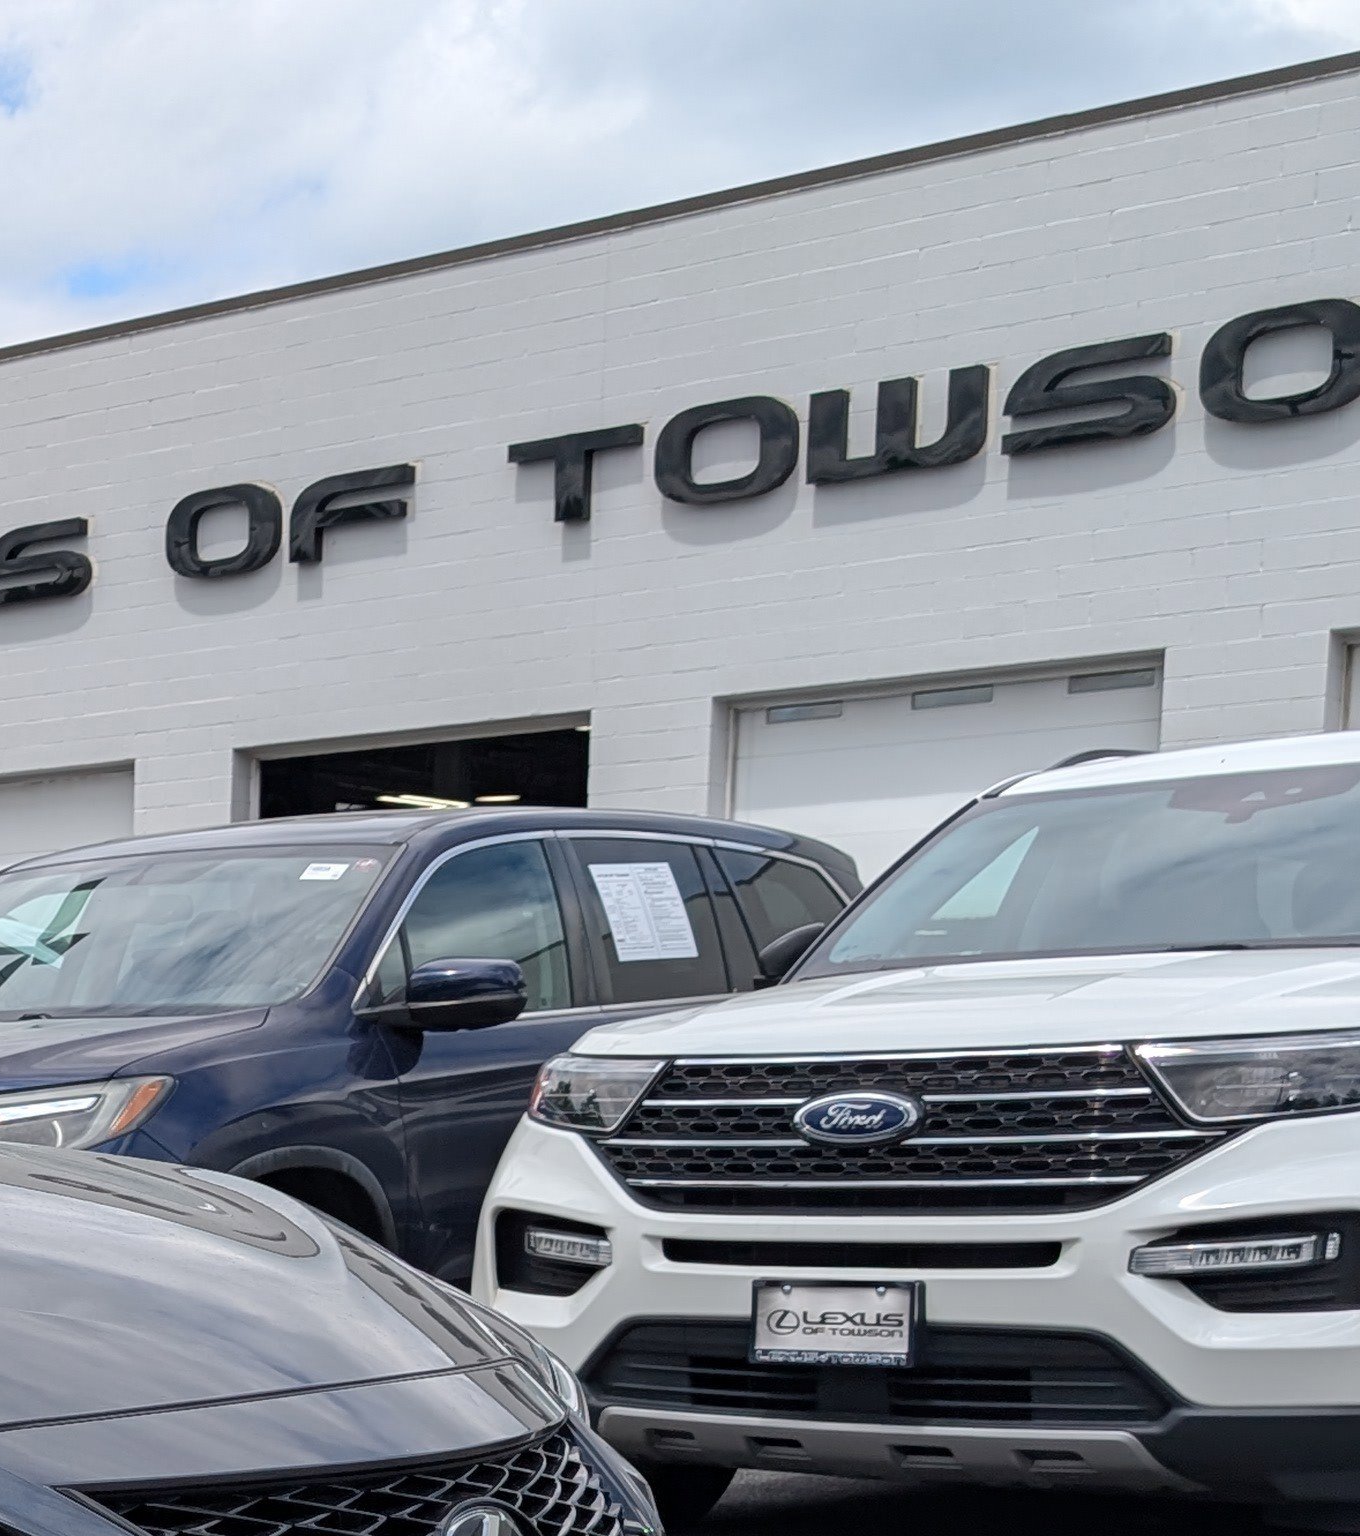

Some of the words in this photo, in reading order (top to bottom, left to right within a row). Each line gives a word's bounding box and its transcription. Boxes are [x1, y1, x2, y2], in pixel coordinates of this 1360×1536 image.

[165, 463, 416, 580] OF
[820, 1102, 887, 1130] Ford
[802, 1310, 904, 1327] LEXUS
[802, 1327, 825, 1336] OF
[827, 1327, 904, 1338] TOWSON
